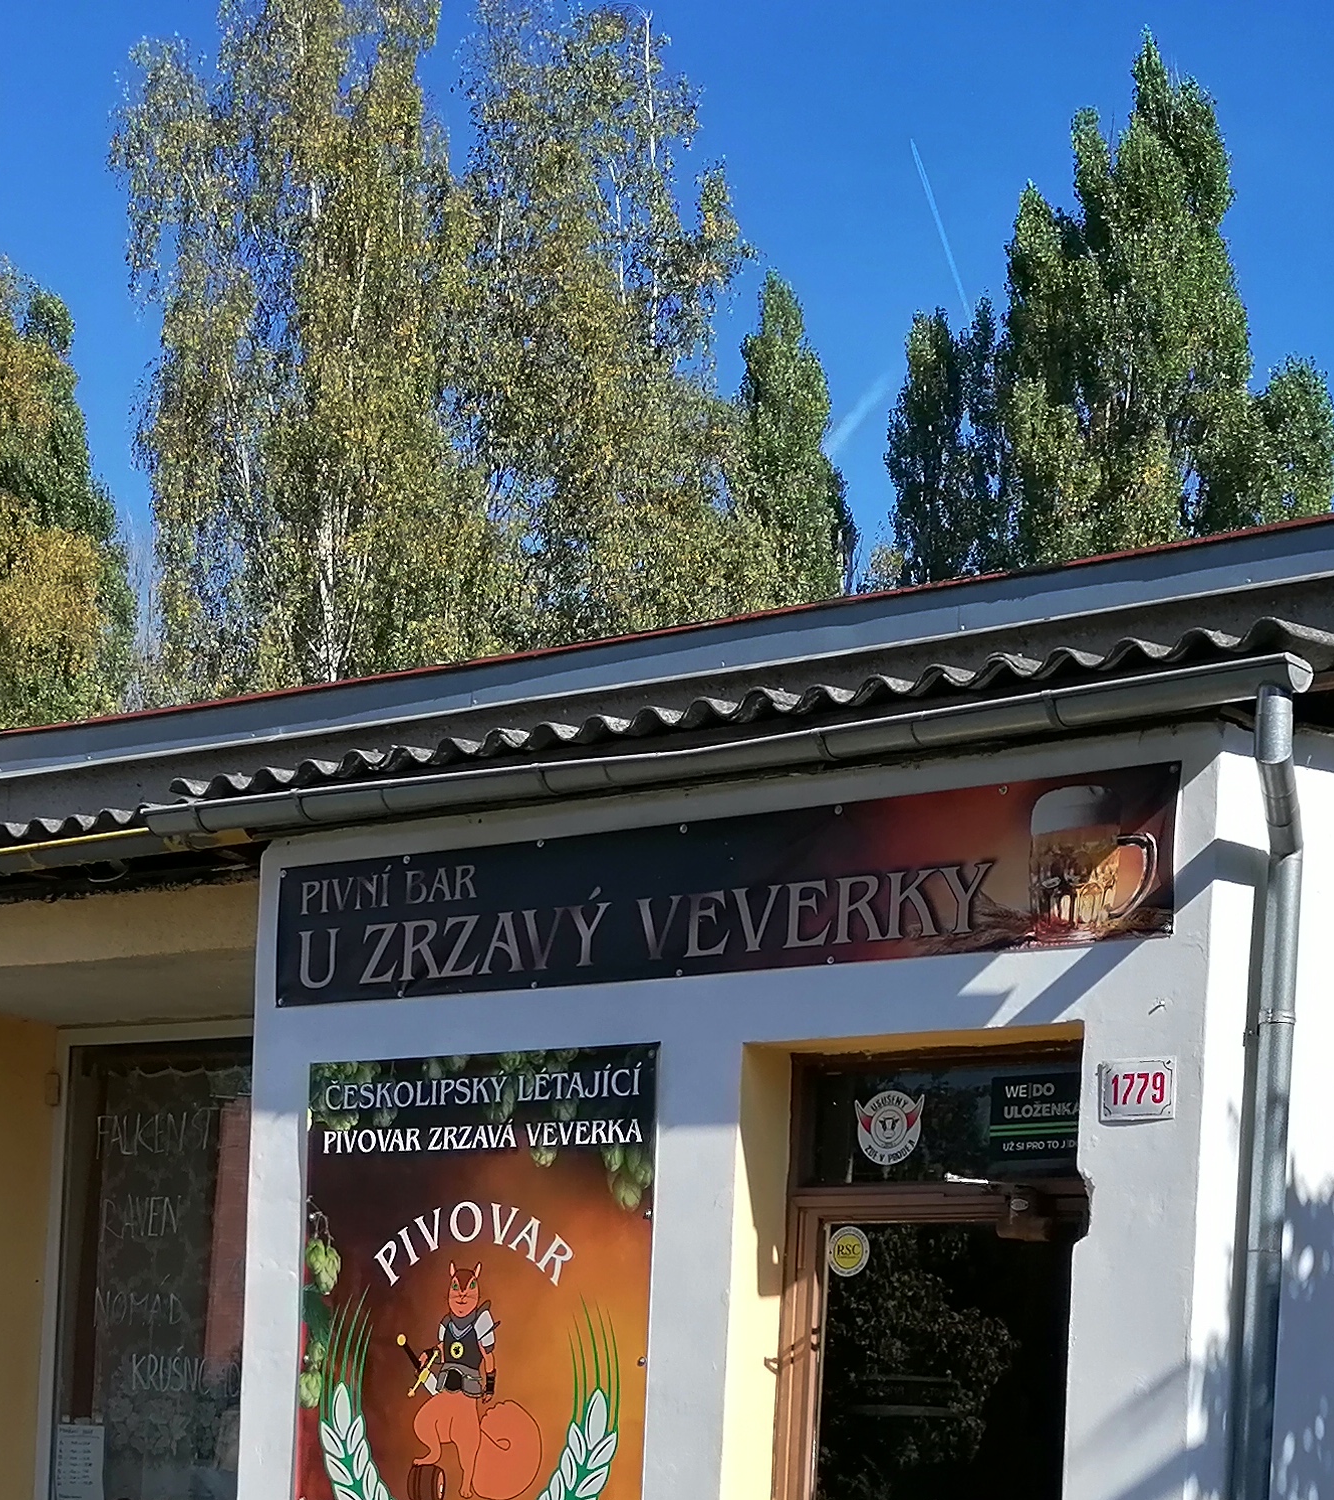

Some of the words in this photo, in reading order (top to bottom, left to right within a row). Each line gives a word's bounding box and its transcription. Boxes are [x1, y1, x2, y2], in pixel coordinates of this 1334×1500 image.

[300, 865, 392, 915] PIVNÍ
[405, 864, 477, 904] BAR
[298, 927, 340, 989] U
[359, 886, 612, 985] ZRZAVÝ
[637, 862, 994, 960] VEVERKY
[324, 1070, 508, 1111] ČESKOLIPSKÝ
[518, 1061, 643, 1101] LÉTAJÍCÍ
[1003, 1101, 1080, 1119] ULOŽENKA
[1111, 1071, 1165, 1106] 1779
[323, 1128, 421, 1154] PIVOVAR
[428, 1120, 517, 1151] ZRZAVÁ
[526, 1118, 643, 1147] VEVERKA
[1002, 1141, 1015, 1151] UŽ
[1016, 1142, 1025, 1151] SI
[1026, 1141, 1045, 1150] PRO
[1047, 1140, 1059, 1149] TO
[99, 1194, 181, 1242] RAVEN
[374, 1201, 575, 1287] PIVOVAR
[837, 1244, 861, 1256] RSC
[94, 1274, 184, 1327] NOMÁD
